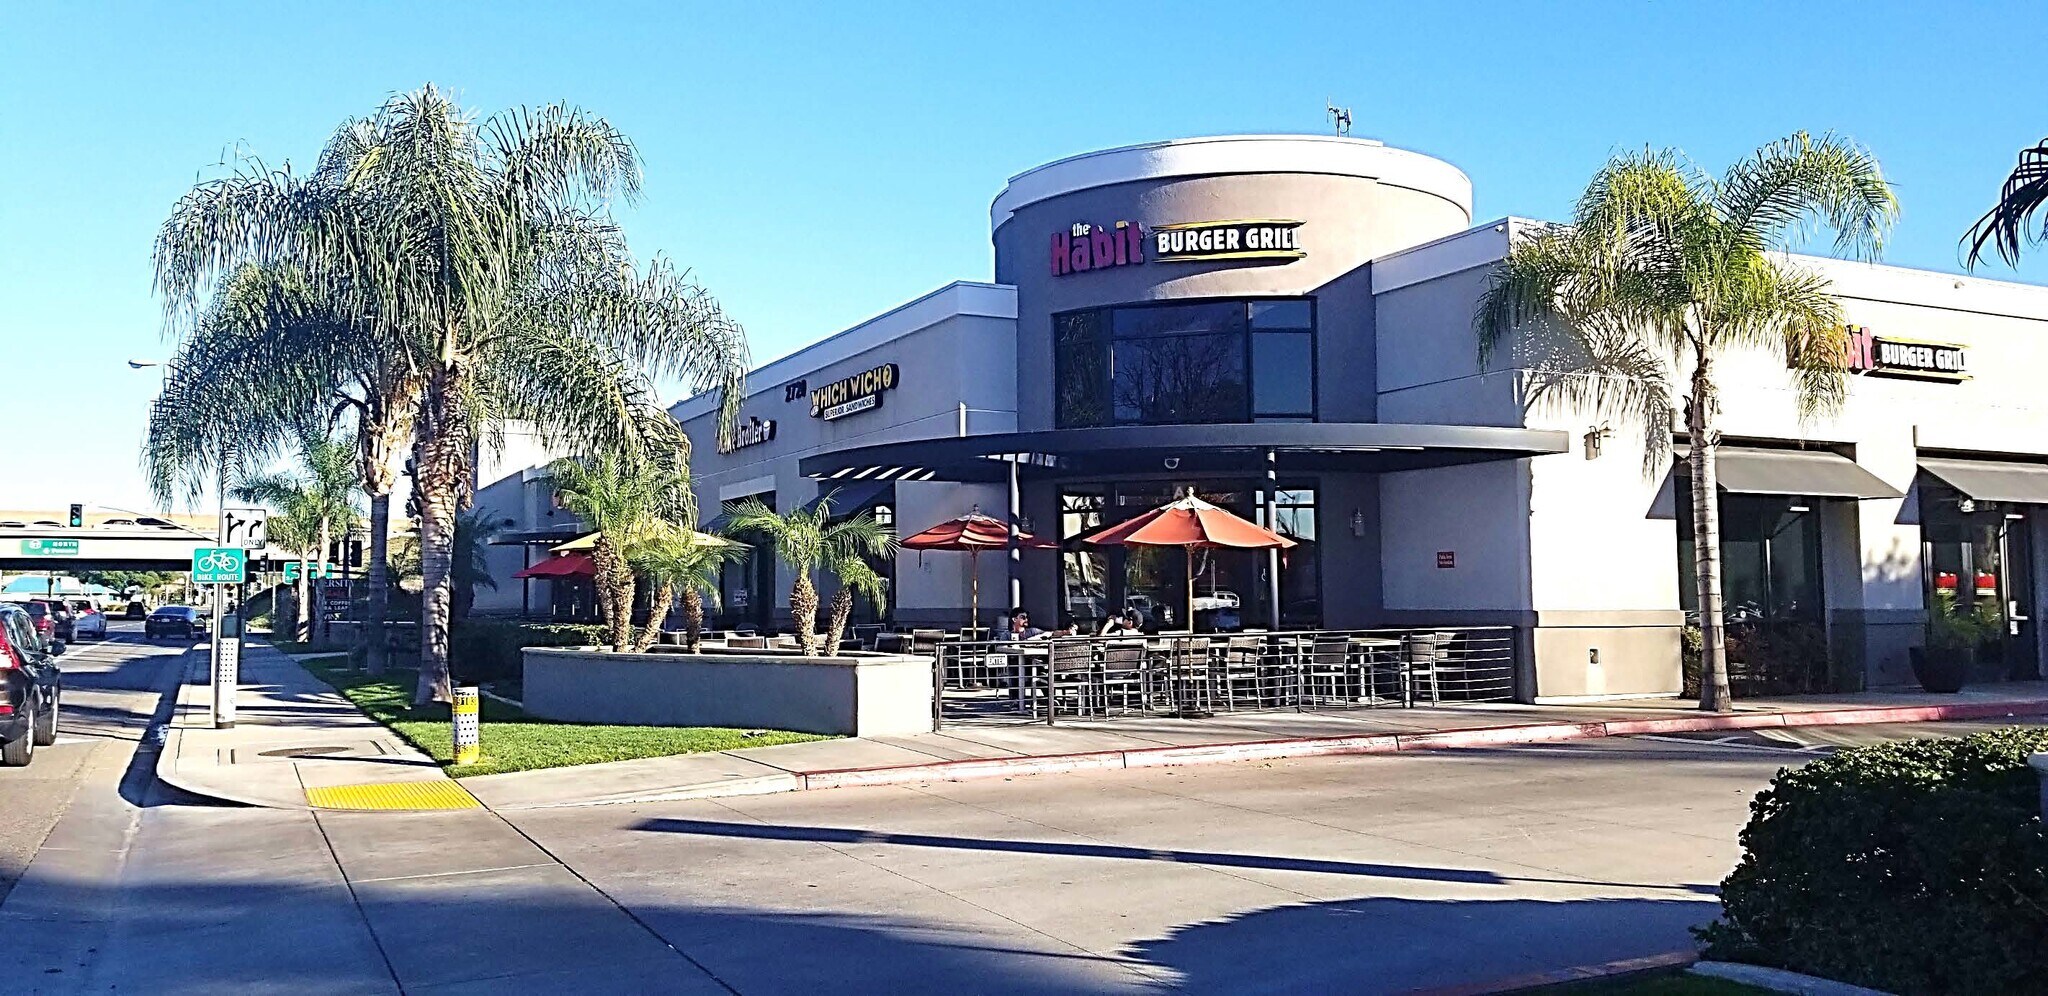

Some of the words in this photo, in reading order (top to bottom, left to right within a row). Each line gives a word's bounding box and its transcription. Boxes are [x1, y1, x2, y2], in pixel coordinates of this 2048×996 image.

[1072, 222, 1091, 238] the
[1050, 220, 1144, 277] Habit
[1157, 227, 1240, 253] BURGER
[1245, 226, 1301, 250] GRILL
[1880, 343, 1935, 368] BURGER
[810, 379, 848, 409] WHICH
[825, 407, 845, 419] SUPERIOR
[846, 396, 875, 413] SANDWICHES
[736, 418, 763, 448] Broiler
[196, 573, 214, 581] BIKE
[216, 573, 240, 581] ROUTE
